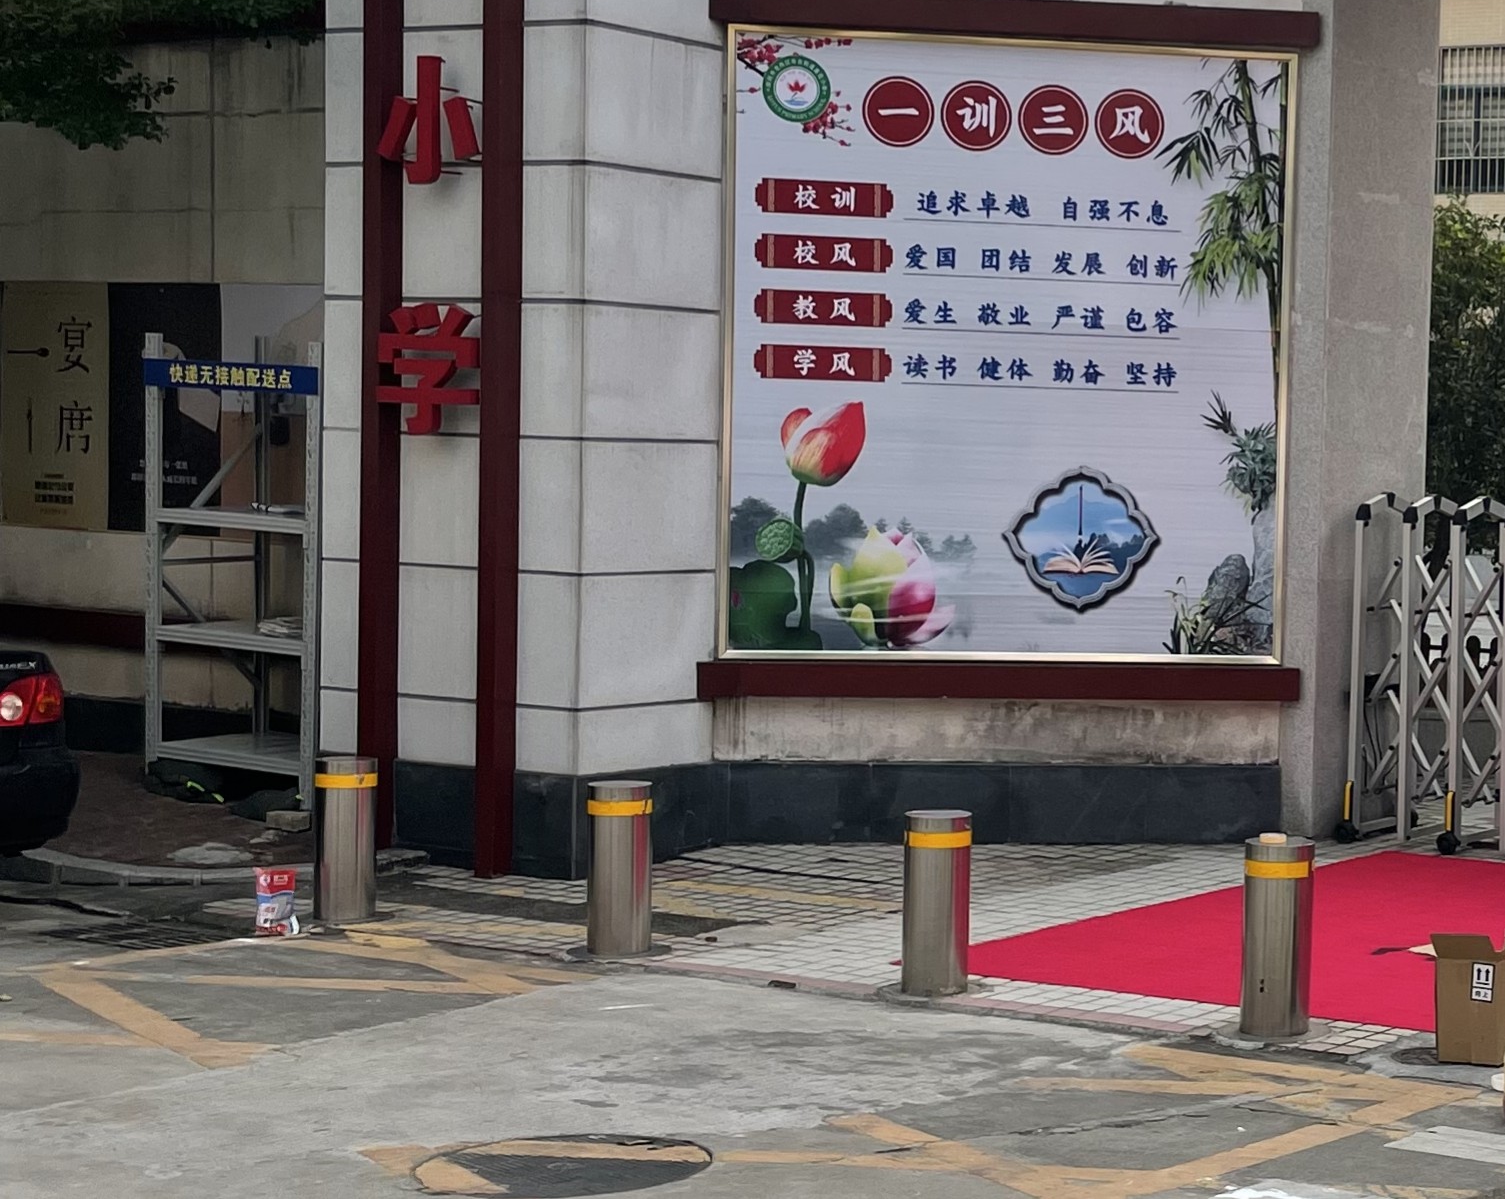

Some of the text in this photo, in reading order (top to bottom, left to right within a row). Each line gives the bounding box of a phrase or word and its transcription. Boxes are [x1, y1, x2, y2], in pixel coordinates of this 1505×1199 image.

[877, 96, 1151, 146] 一训三风
[793, 184, 1169, 226] 校训 追求卓越 自强不息
[793, 239, 1179, 280] 校风 爱国 团结 发展 创新
[793, 294, 1178, 334] 教风 爱生 敬业 严谨 包容
[169, 363, 292, 390] 快递无接触配送点
[793, 349, 1178, 388] 学风 读书 健体 勤奋 坚持
